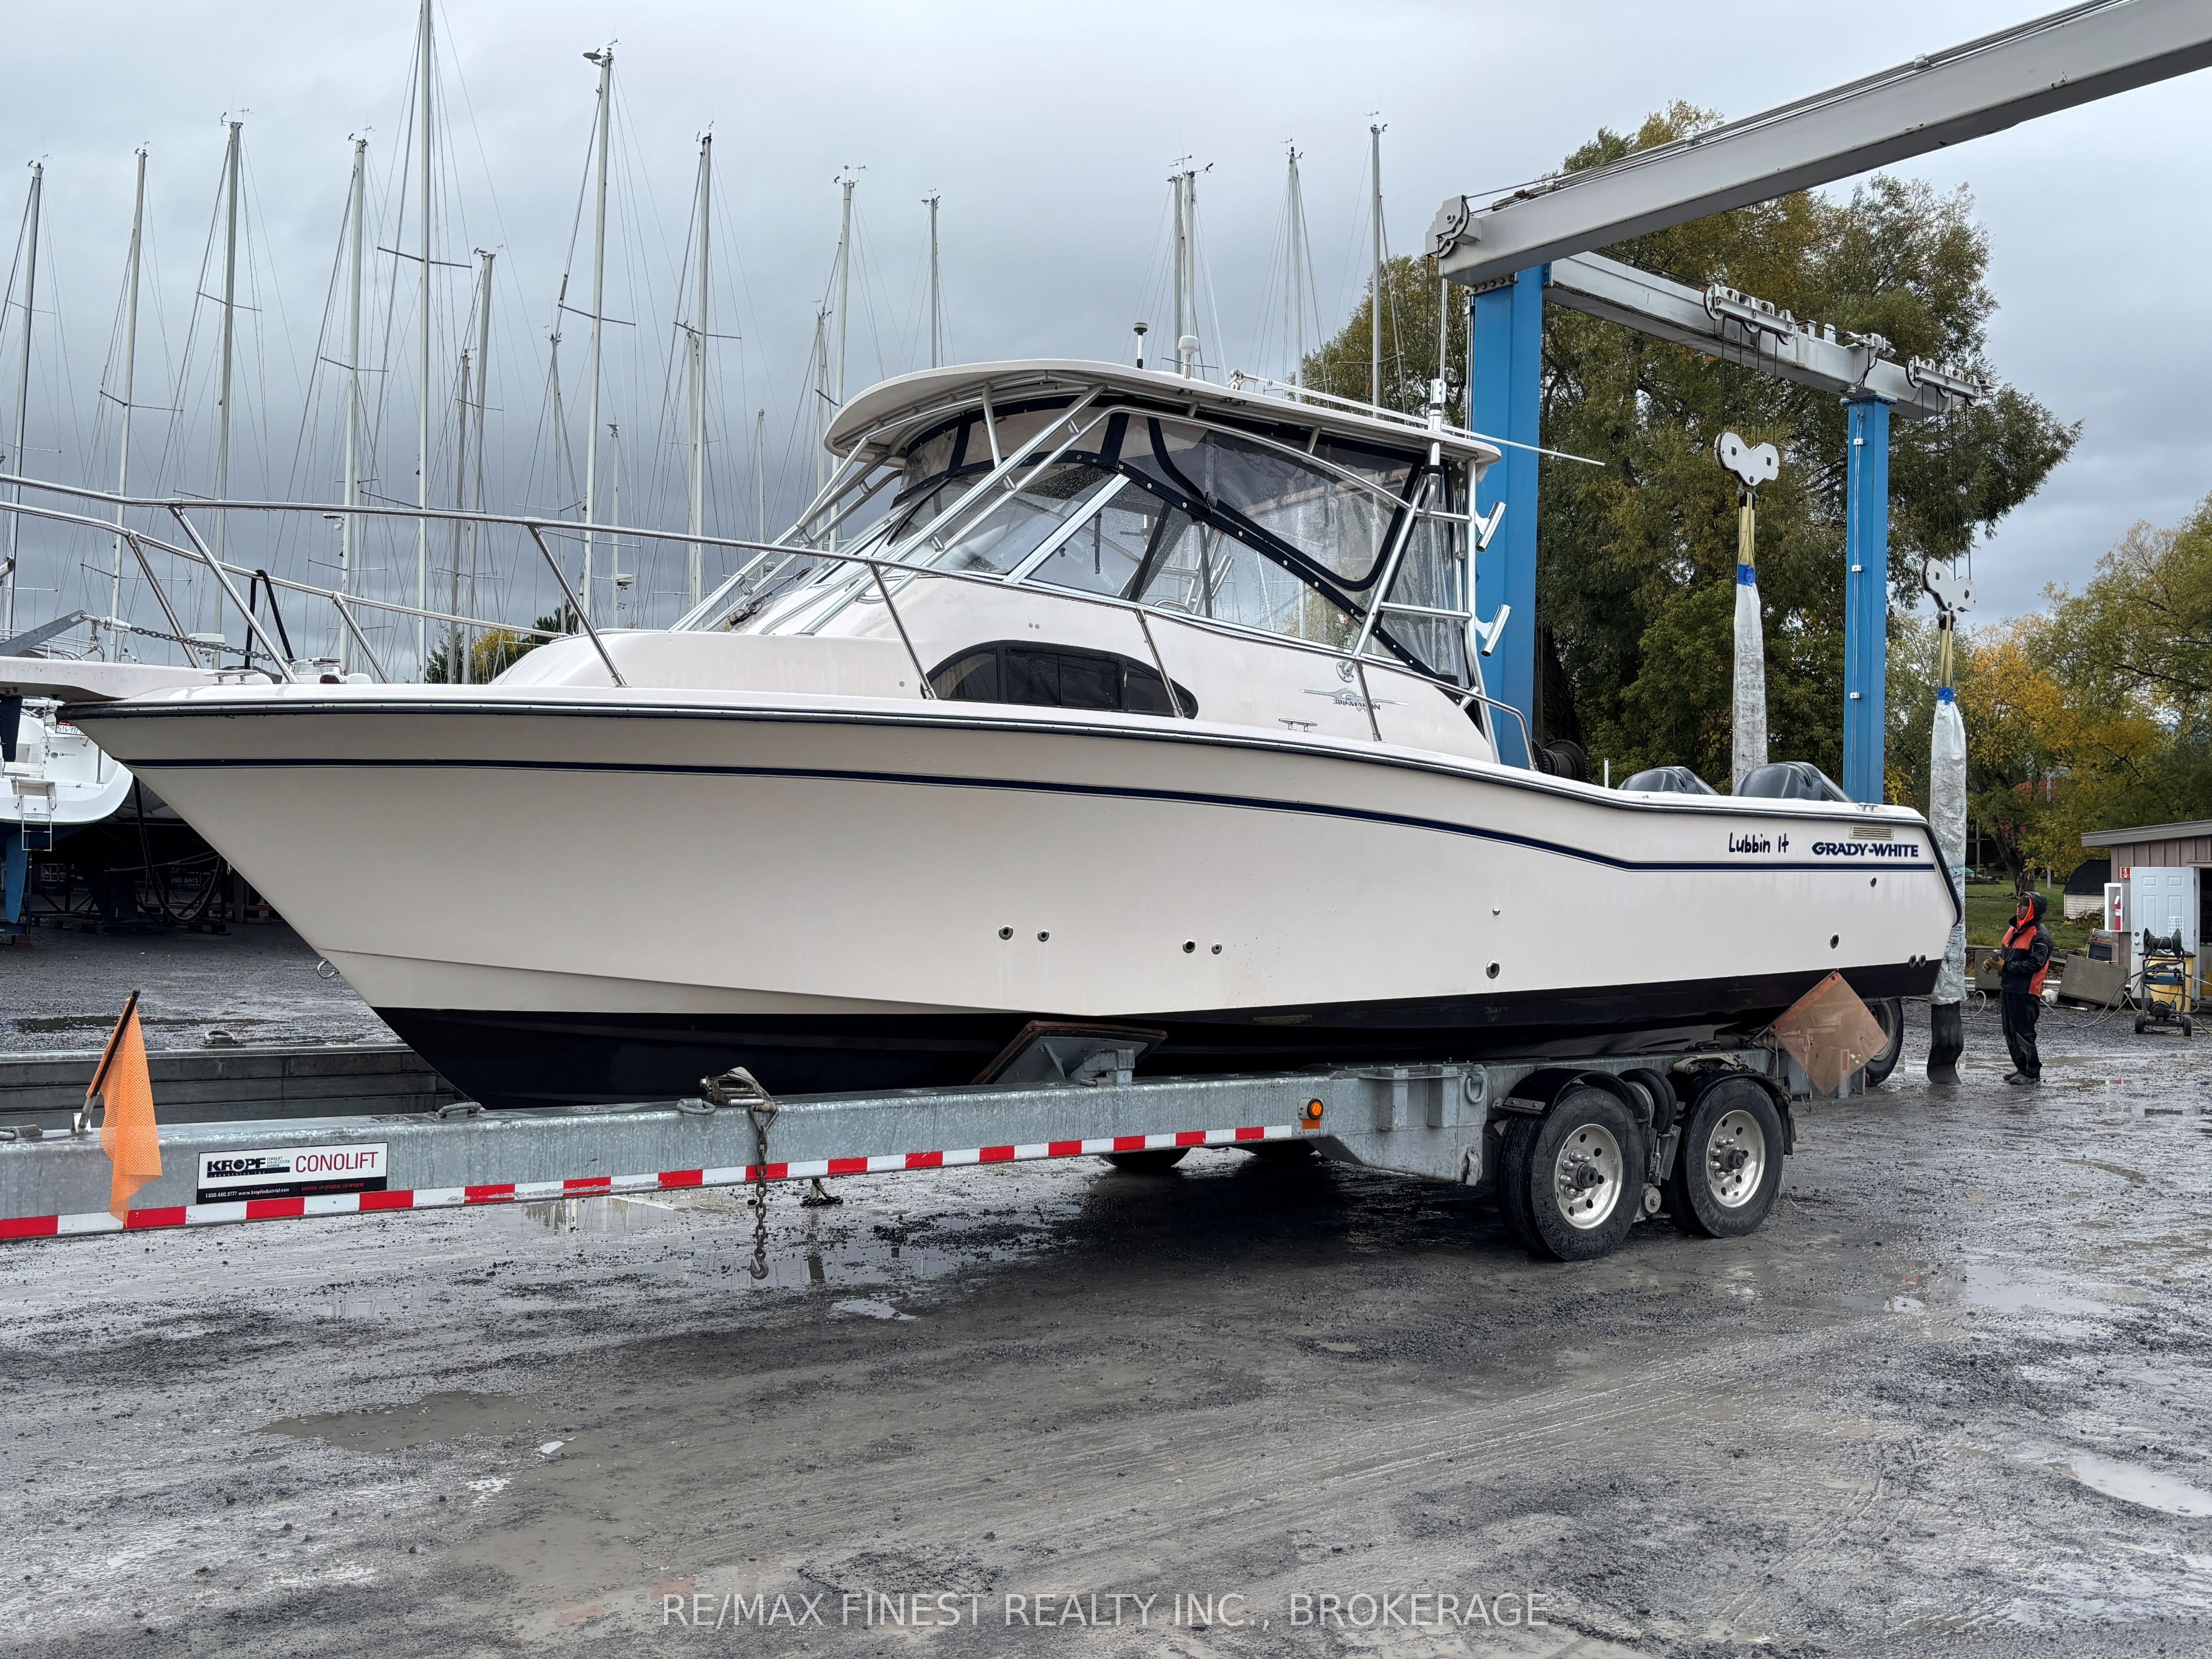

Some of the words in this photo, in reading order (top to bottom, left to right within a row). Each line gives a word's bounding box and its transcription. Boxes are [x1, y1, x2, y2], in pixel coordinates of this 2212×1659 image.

[1349, 700, 1380, 710] MAIN
[1728, 832, 1770, 854] Lubbin
[1812, 842, 1919, 857] GRADY-WHITE
[207, 1157, 266, 1172] KROPF
[296, 1152, 378, 1173] CONOLIFT
